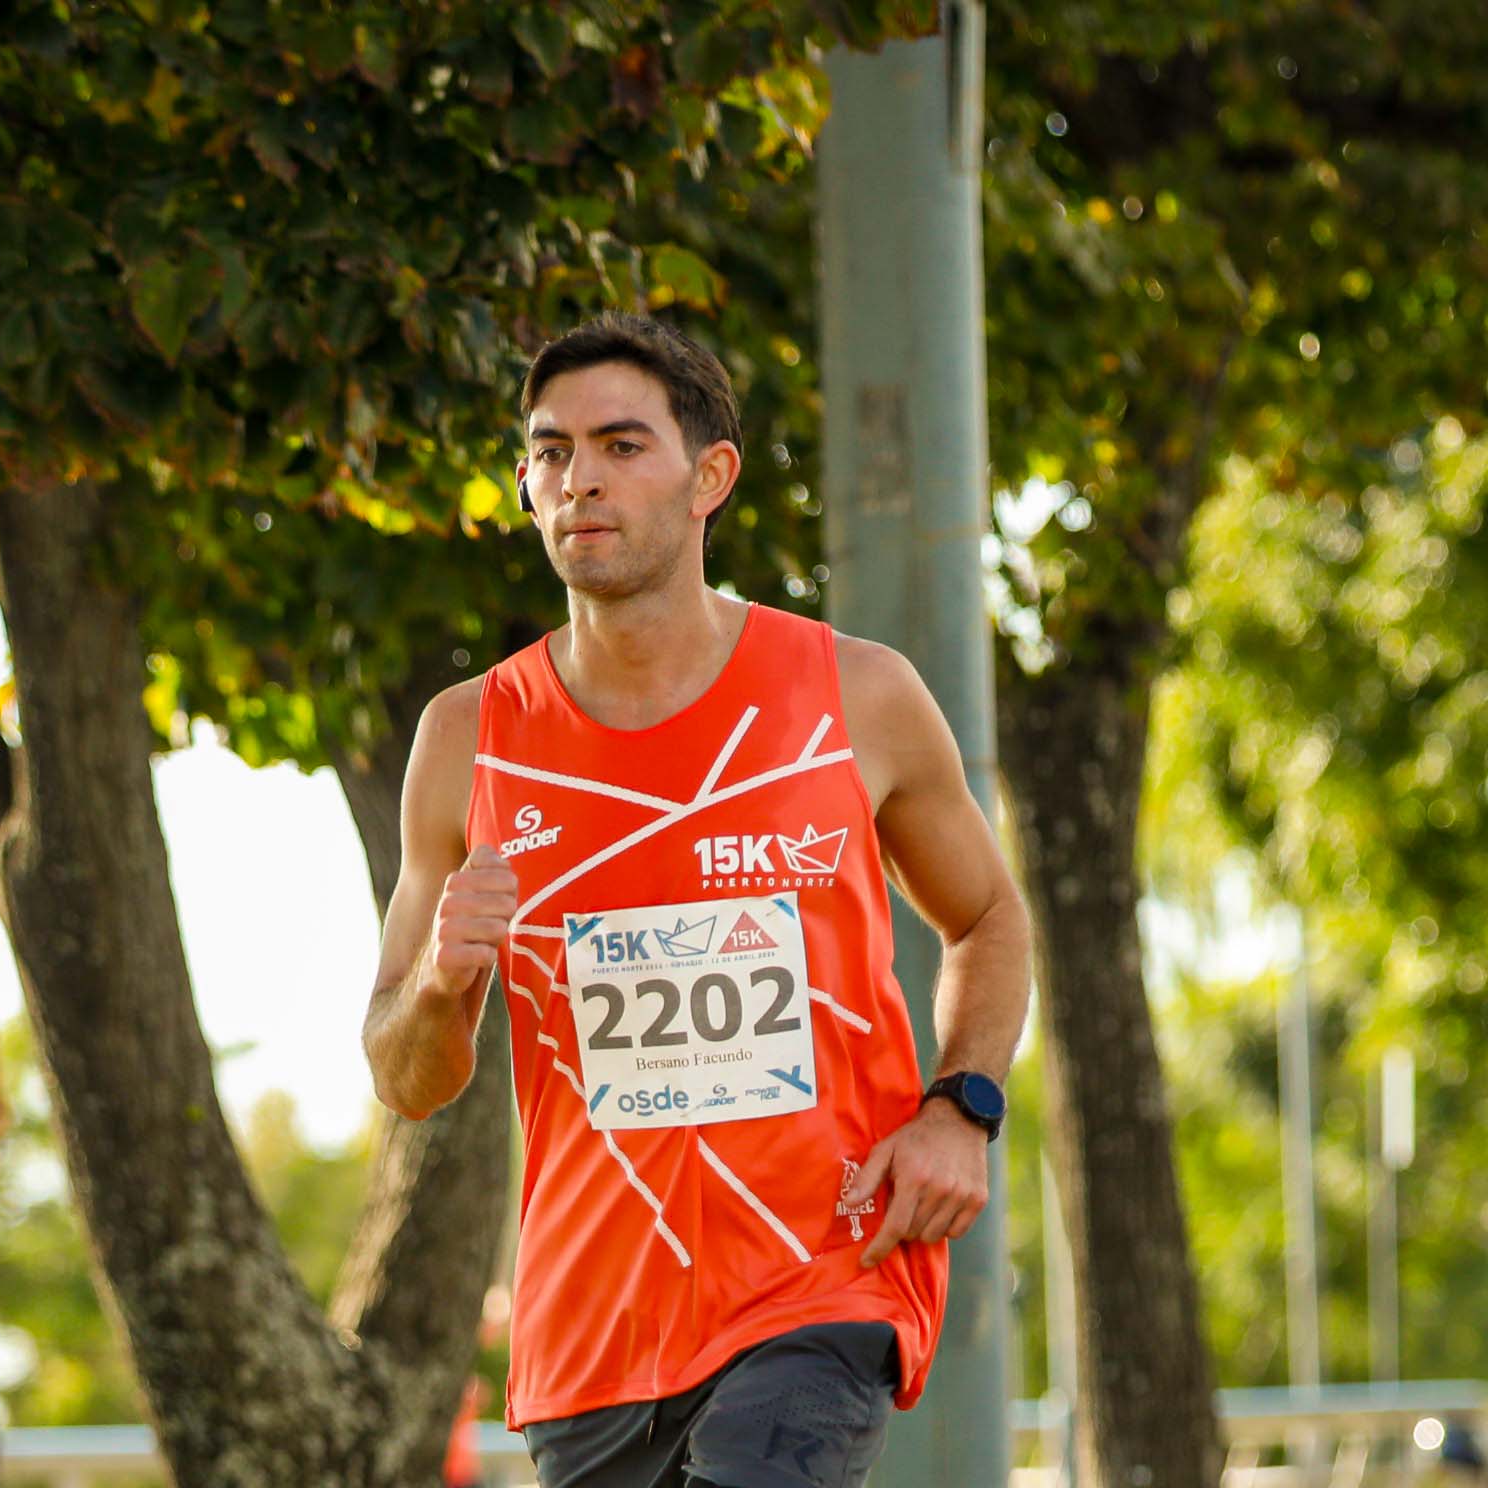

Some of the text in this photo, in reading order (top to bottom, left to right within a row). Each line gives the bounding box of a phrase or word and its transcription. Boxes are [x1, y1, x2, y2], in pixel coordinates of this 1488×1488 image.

[694, 834, 776, 876] 15K
[702, 877, 835, 889] PUERTO NORTE
[590, 929, 650, 963] 15K
[729, 928, 763, 948] 15K
[581, 966, 802, 1051] 2202
[635, 1048, 753, 1071] Bersano Facundo
[617, 1084, 690, 1115] osde
